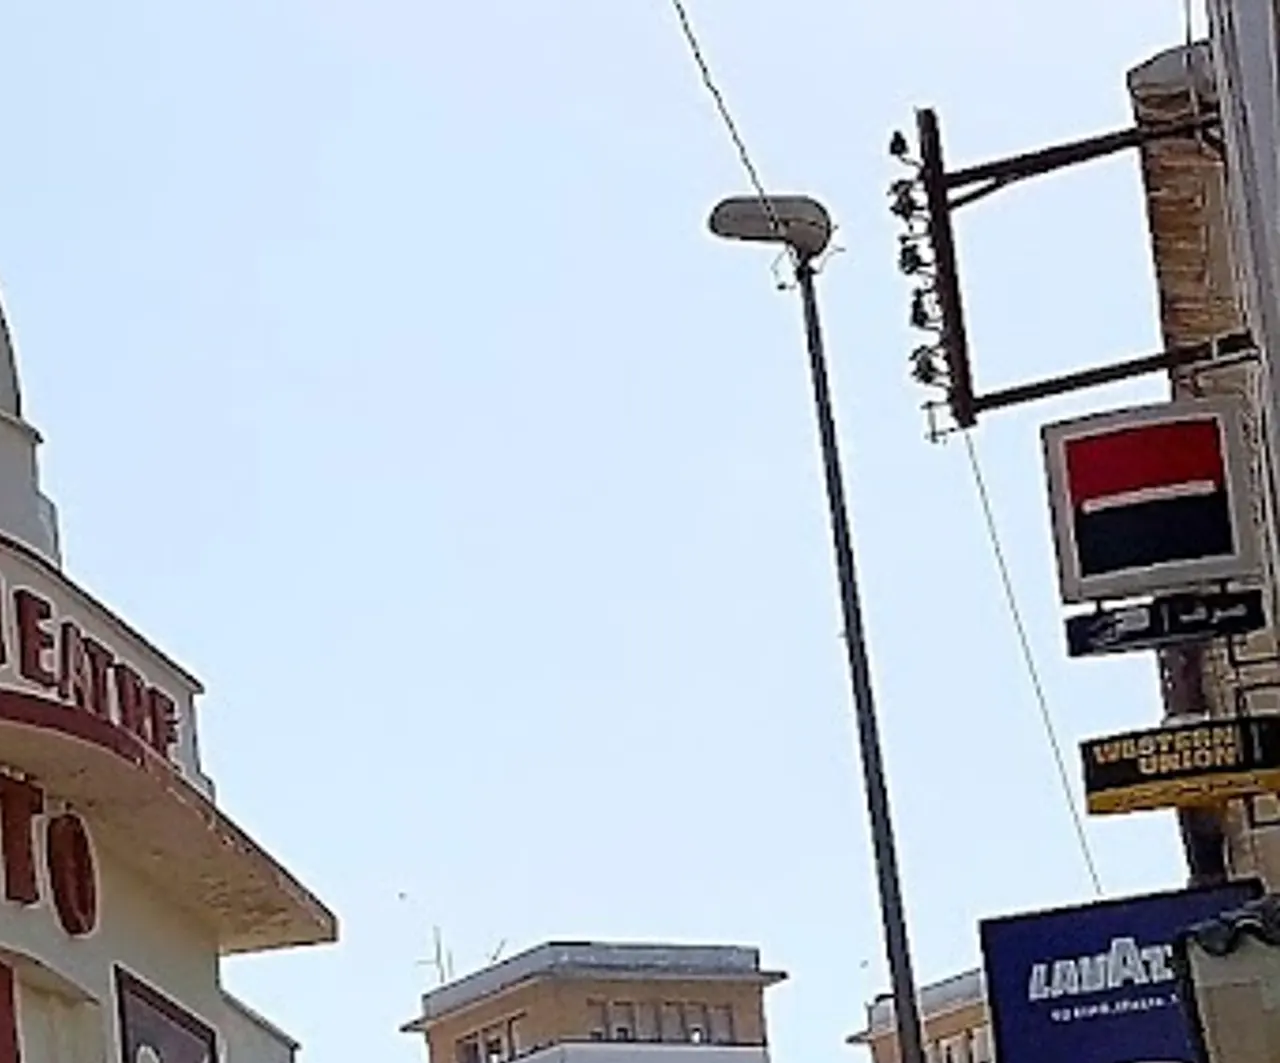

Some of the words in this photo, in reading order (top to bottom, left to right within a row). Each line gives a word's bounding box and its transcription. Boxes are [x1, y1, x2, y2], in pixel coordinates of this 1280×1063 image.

[1092, 727, 1235, 763] WESTERN
[1140, 746, 1236, 775] UNION
[1028, 936, 1175, 1002] LAVAZ
